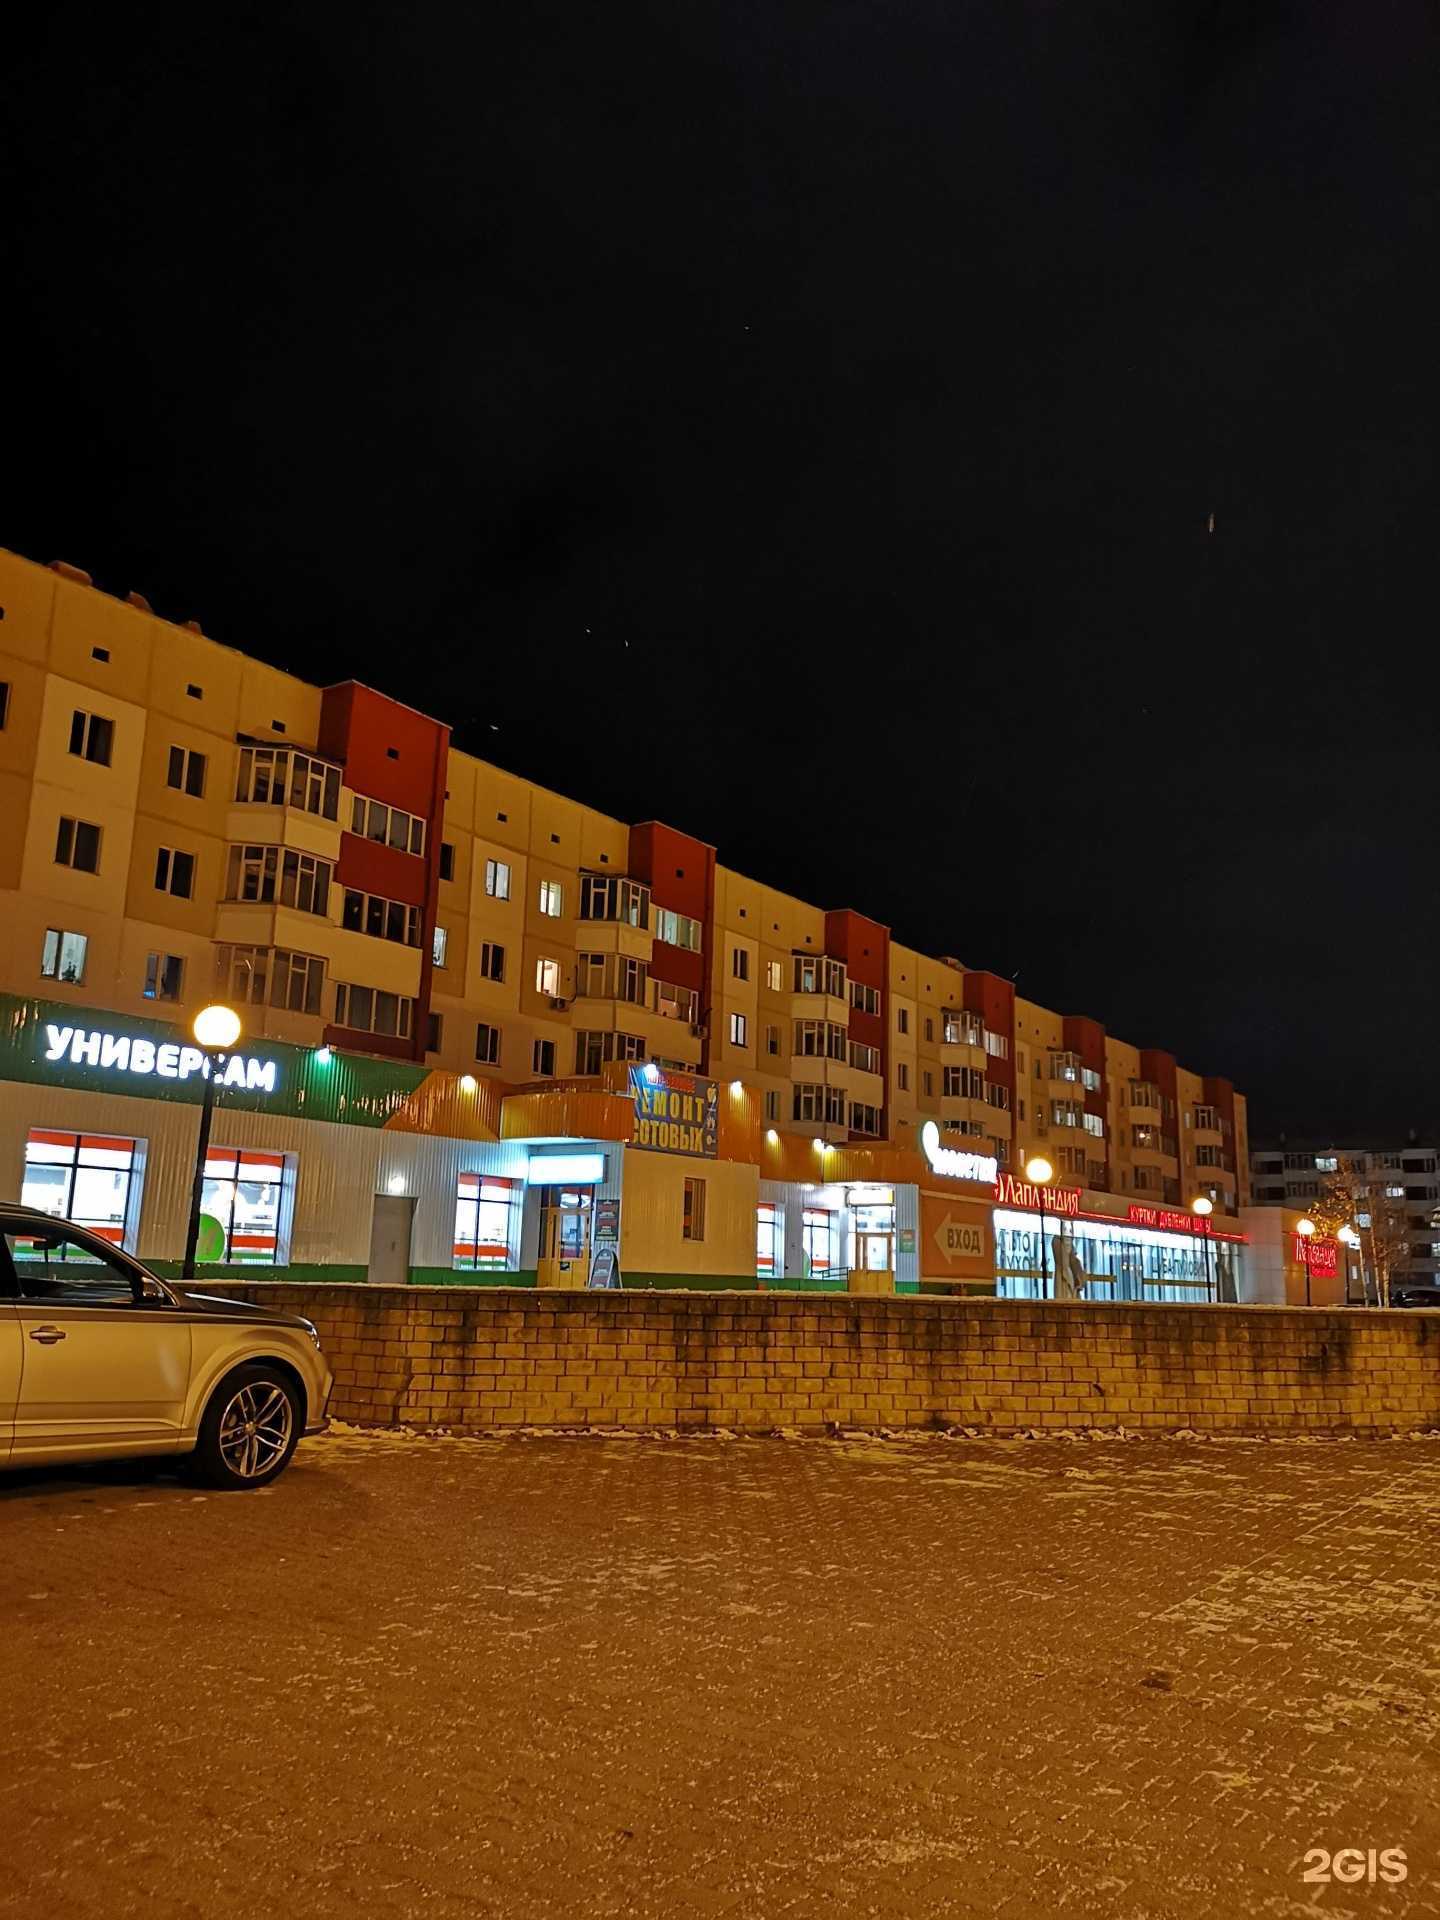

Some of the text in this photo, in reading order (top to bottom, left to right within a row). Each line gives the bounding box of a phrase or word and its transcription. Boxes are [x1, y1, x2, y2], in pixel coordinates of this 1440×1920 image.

[632, 1087, 704, 1122] ЕМОНТ
[1130, 1205, 1157, 1225] КУРТКИ
[947, 1228, 981, 1254] ВХОД
